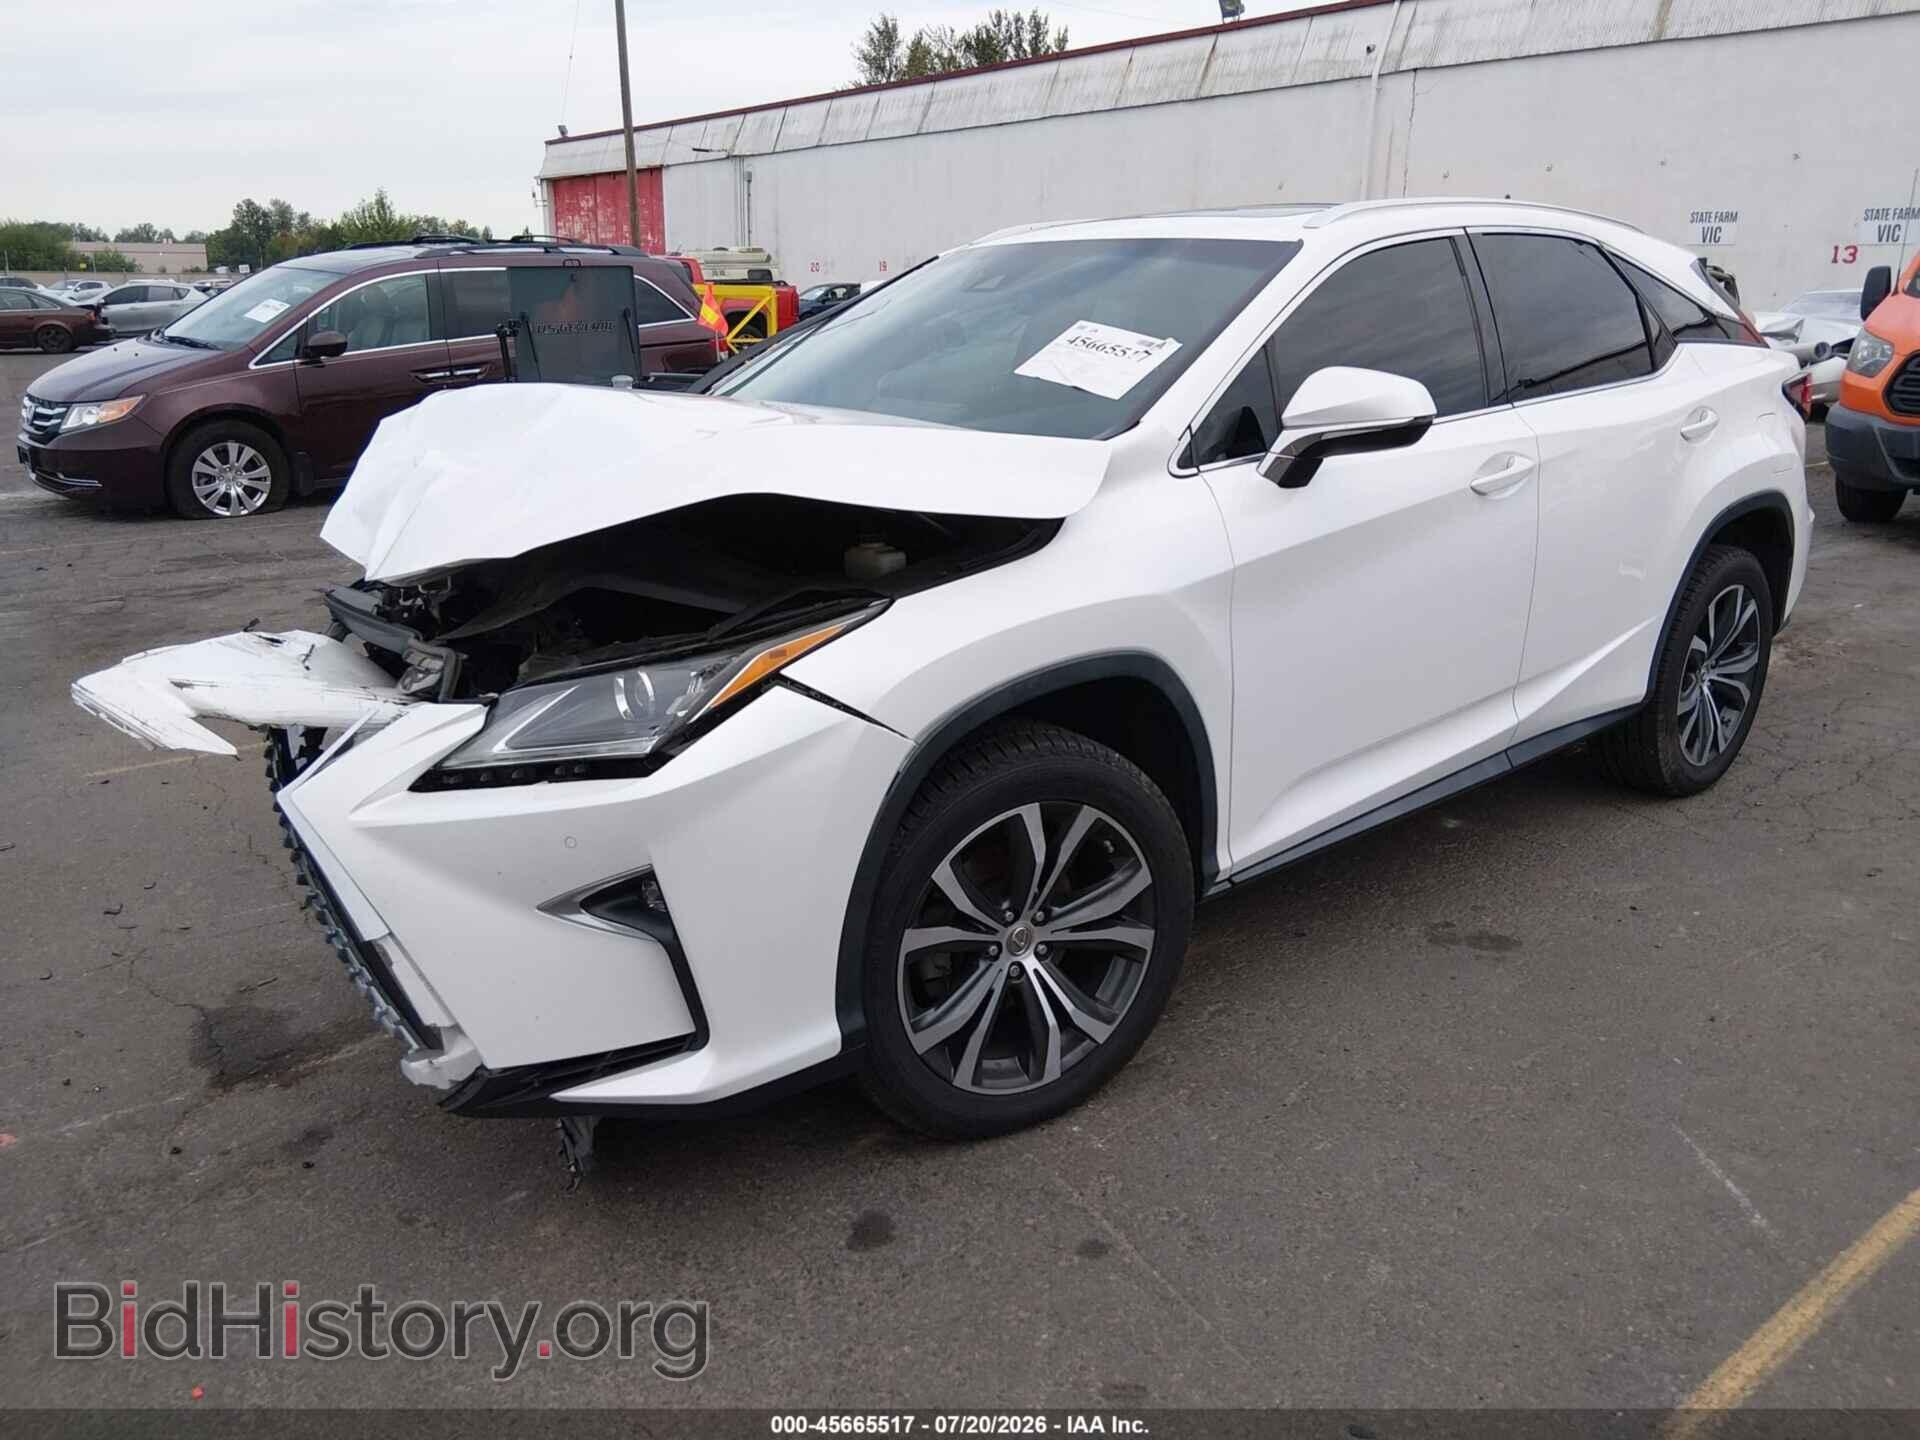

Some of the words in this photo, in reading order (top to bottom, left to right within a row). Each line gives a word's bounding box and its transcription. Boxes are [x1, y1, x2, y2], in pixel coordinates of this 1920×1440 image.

[1690, 211, 1712, 223] STATE
[1714, 211, 1738, 223] FARM
[1863, 208, 1889, 222] STATE
[1892, 207, 1920, 221] FARM
[1702, 227, 1722, 244] VIC
[1877, 224, 1901, 243] VIC
[1831, 245, 1858, 264] 13
